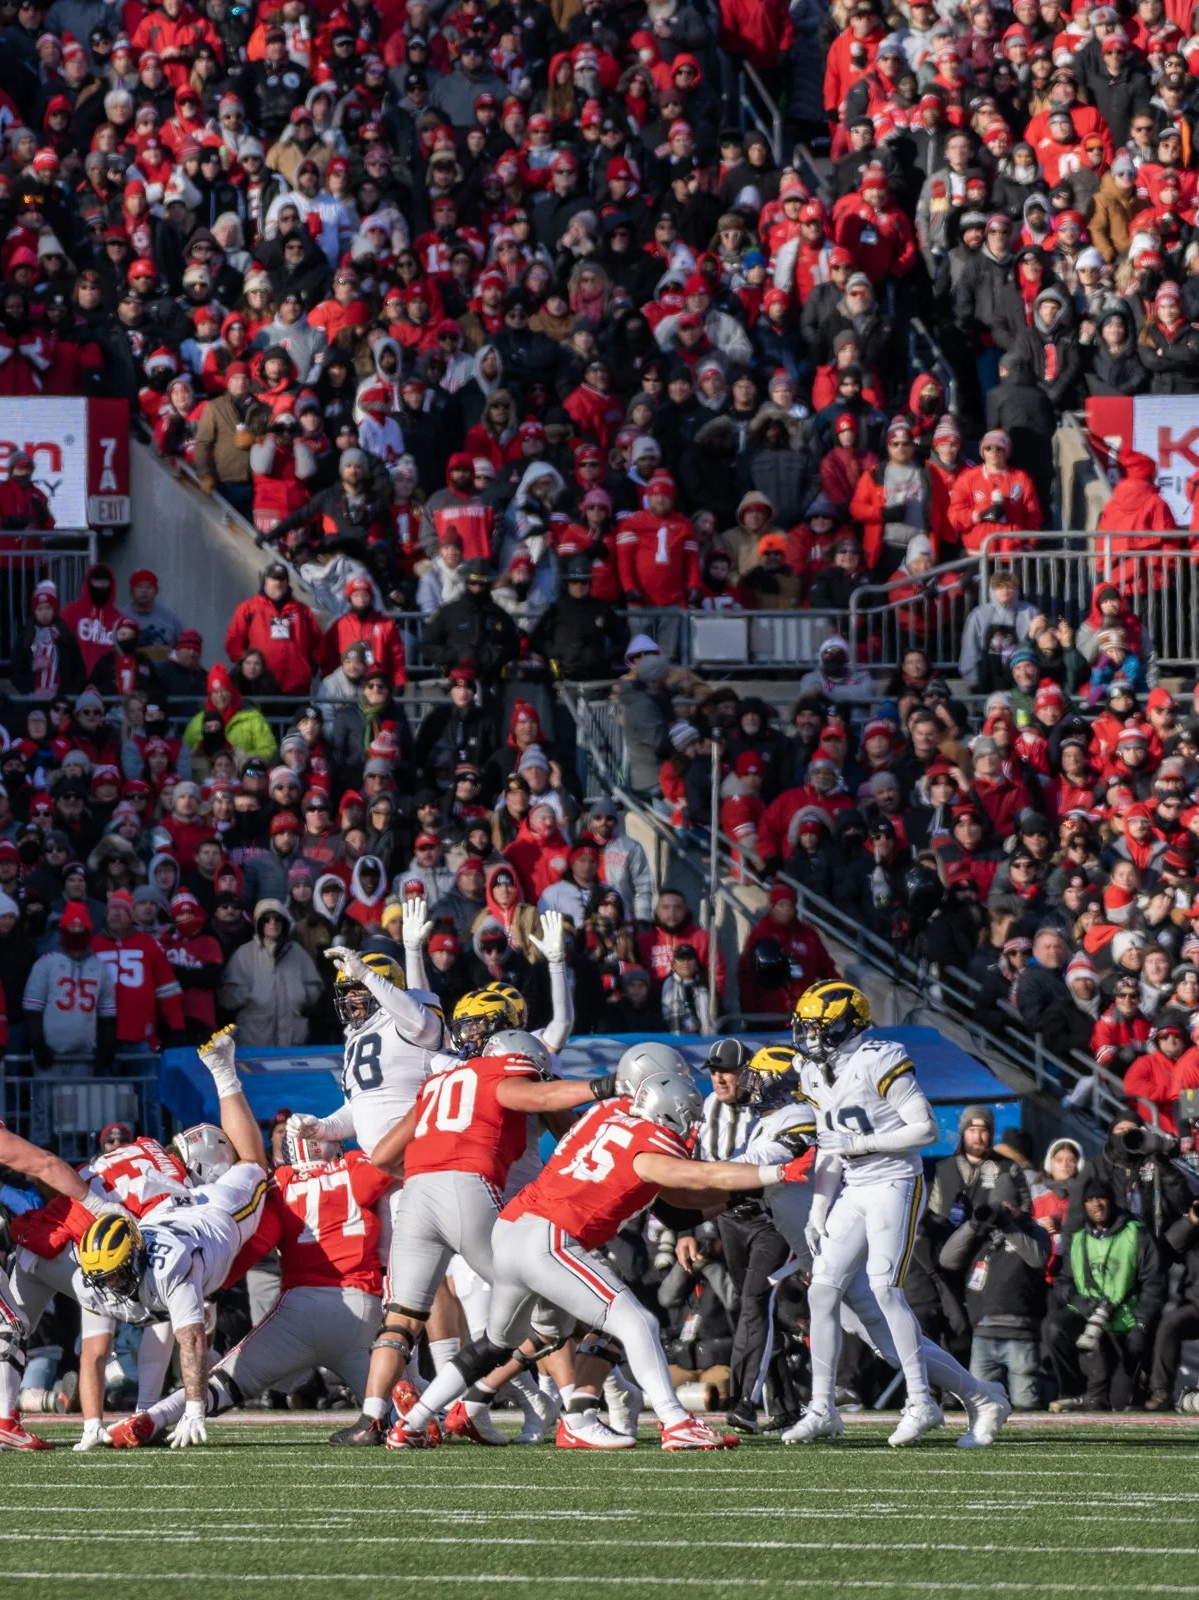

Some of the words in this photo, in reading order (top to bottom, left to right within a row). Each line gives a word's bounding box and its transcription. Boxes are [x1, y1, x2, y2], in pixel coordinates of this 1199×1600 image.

[99, 438, 117, 469] 7
[100, 468, 117, 492] A
[98, 501, 125, 521] EXIT
[655, 526, 670, 564] 1
[120, 669, 132, 696] 1
[56, 976, 98, 1013] 35
[414, 1067, 478, 1133] 70
[286, 1169, 366, 1244] 77
